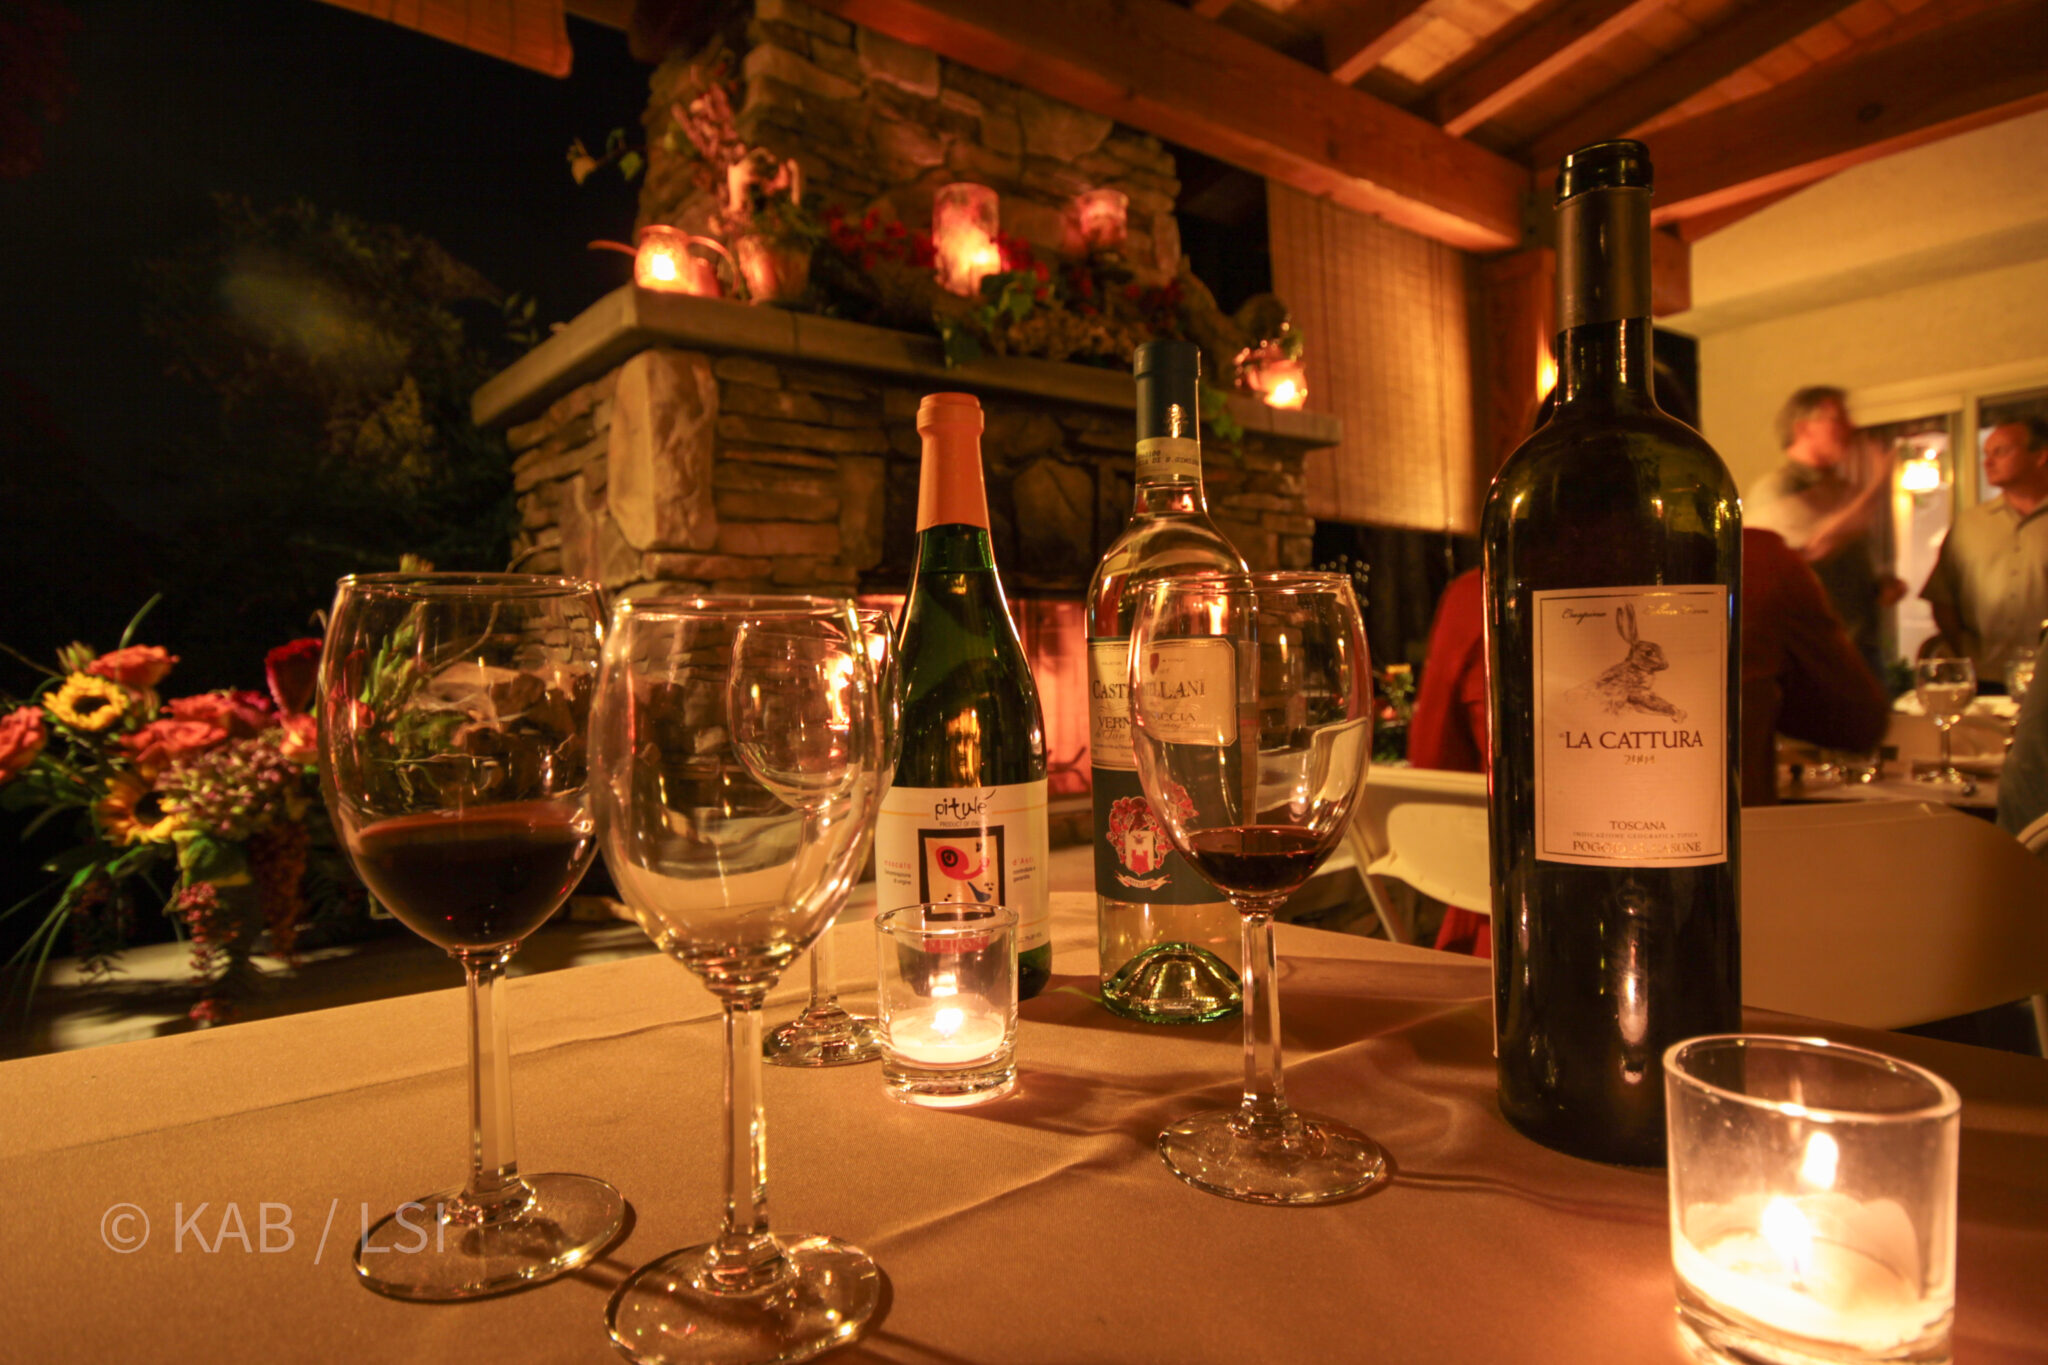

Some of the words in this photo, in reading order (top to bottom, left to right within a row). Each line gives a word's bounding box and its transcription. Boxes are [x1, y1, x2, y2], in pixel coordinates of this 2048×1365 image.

[1565, 731, 1593, 749] LA
[1599, 730, 1704, 749] CATTURA
[1608, 820, 1667, 832] TOSCANA
